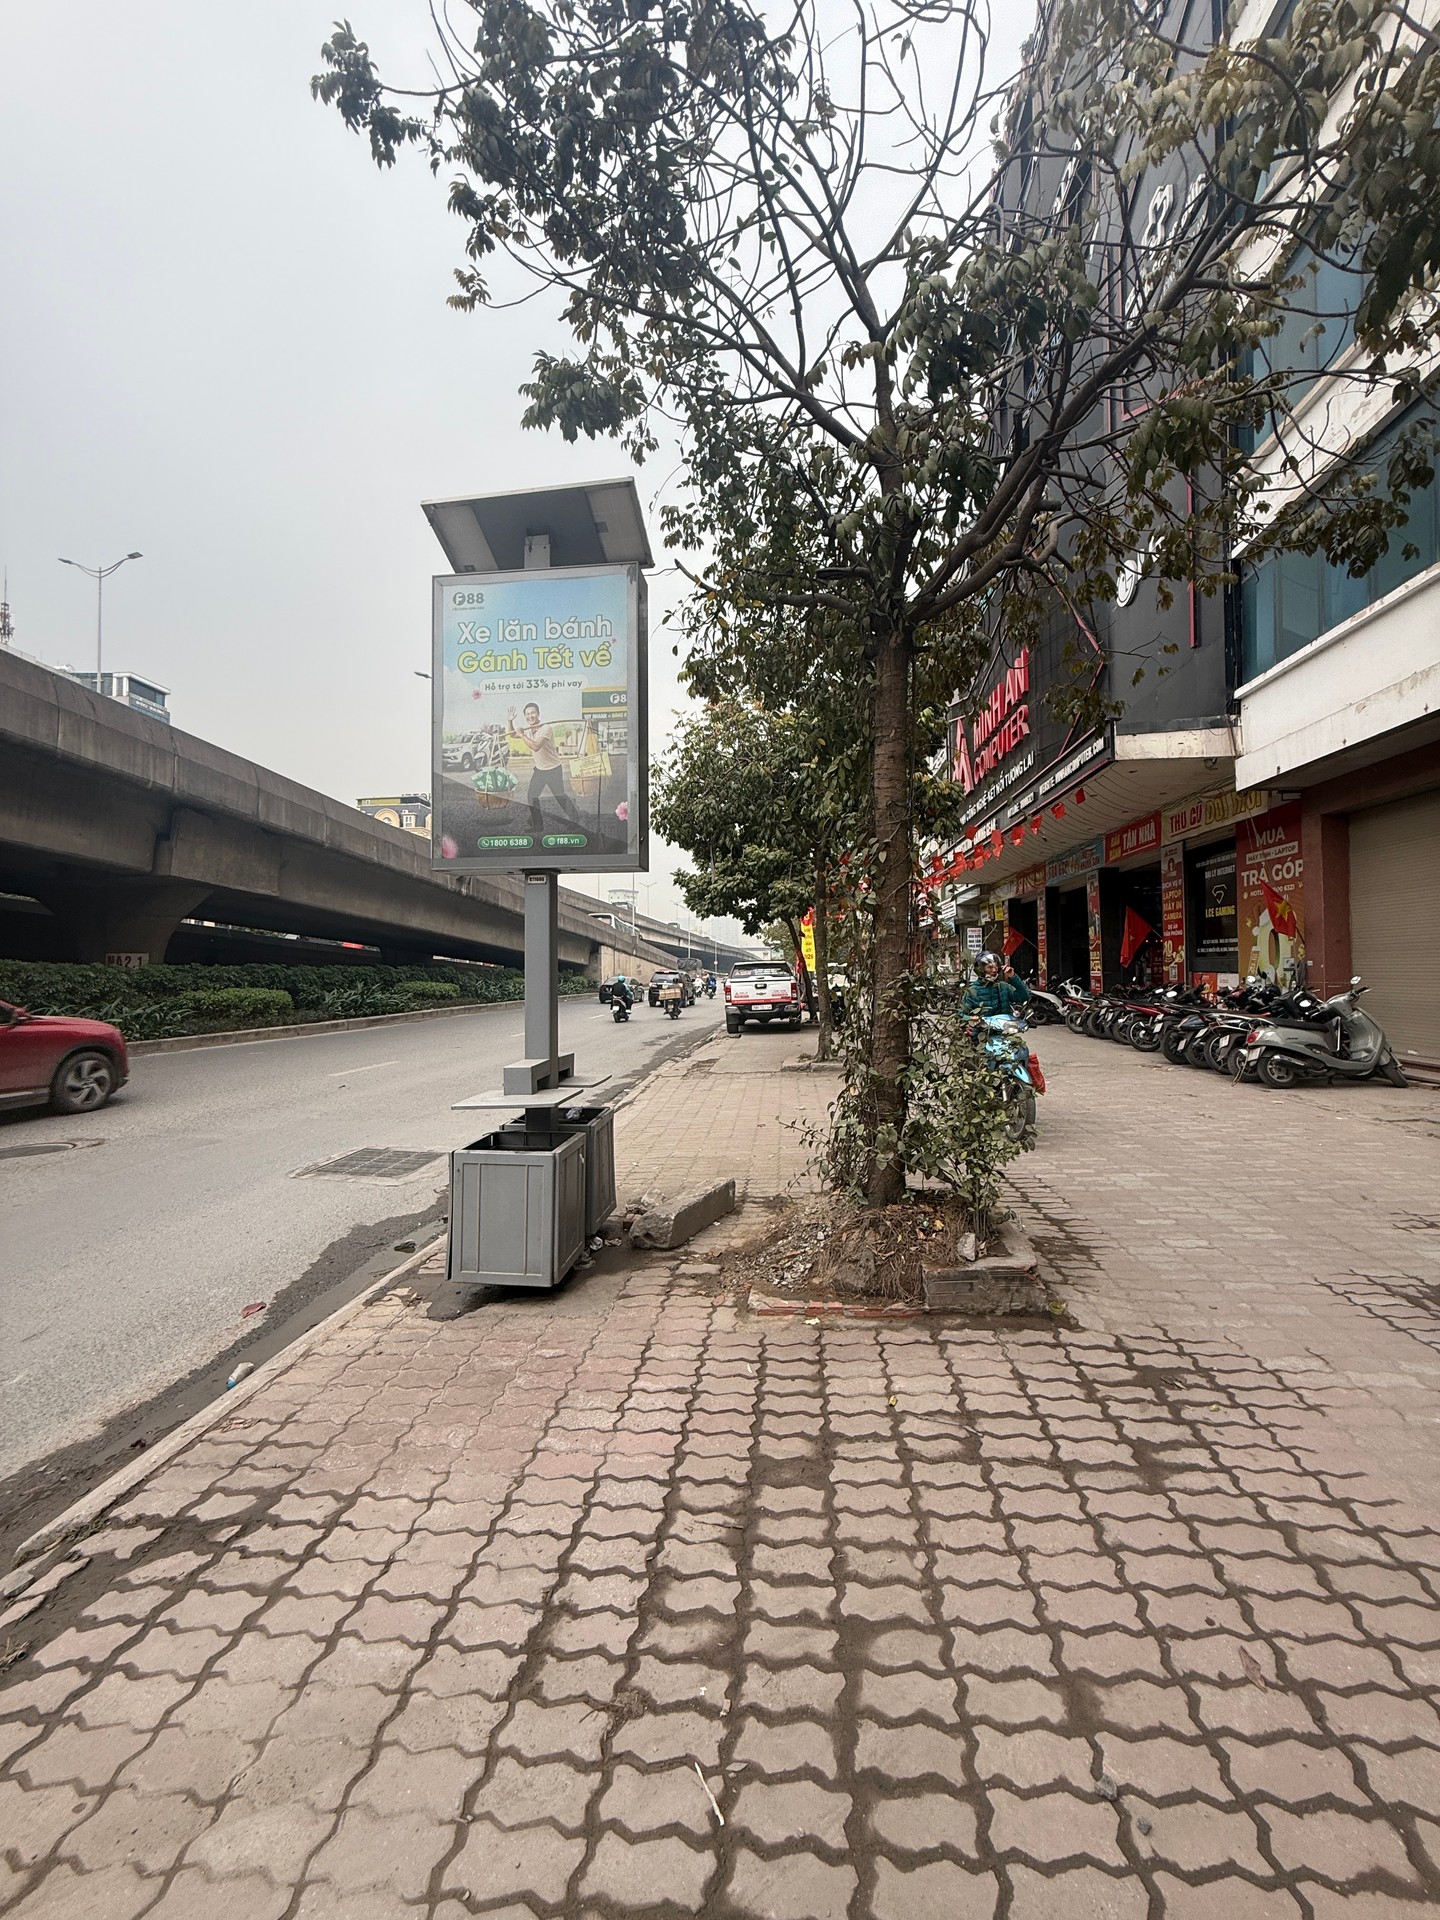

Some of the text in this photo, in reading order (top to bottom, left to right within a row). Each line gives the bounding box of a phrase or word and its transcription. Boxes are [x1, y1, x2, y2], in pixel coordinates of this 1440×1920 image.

[452, 592, 485, 606] F88
[457, 614, 613, 645] Xe lăn bánh
[457, 641, 612, 674] Gánh Tết về
[526, 678, 549, 689] 33%
[567, 680, 583, 689] vay
[1004, 647, 1029, 715] AN
[974, 703, 1030, 785] COMPUTER
[1023, 750, 1034, 773] LAI
[1170, 813, 1187, 834] THU
[1189, 802, 1203, 828] CŨ
[490, 837, 528, 847] 1800 6388
[556, 837, 580, 845] f88.vn
[1138, 819, 1156, 845] NHÀ
[1256, 826, 1286, 848] MUA
[1274, 844, 1297, 857] LAPTOP
[1241, 857, 1304, 887] TRẢ GÓP
